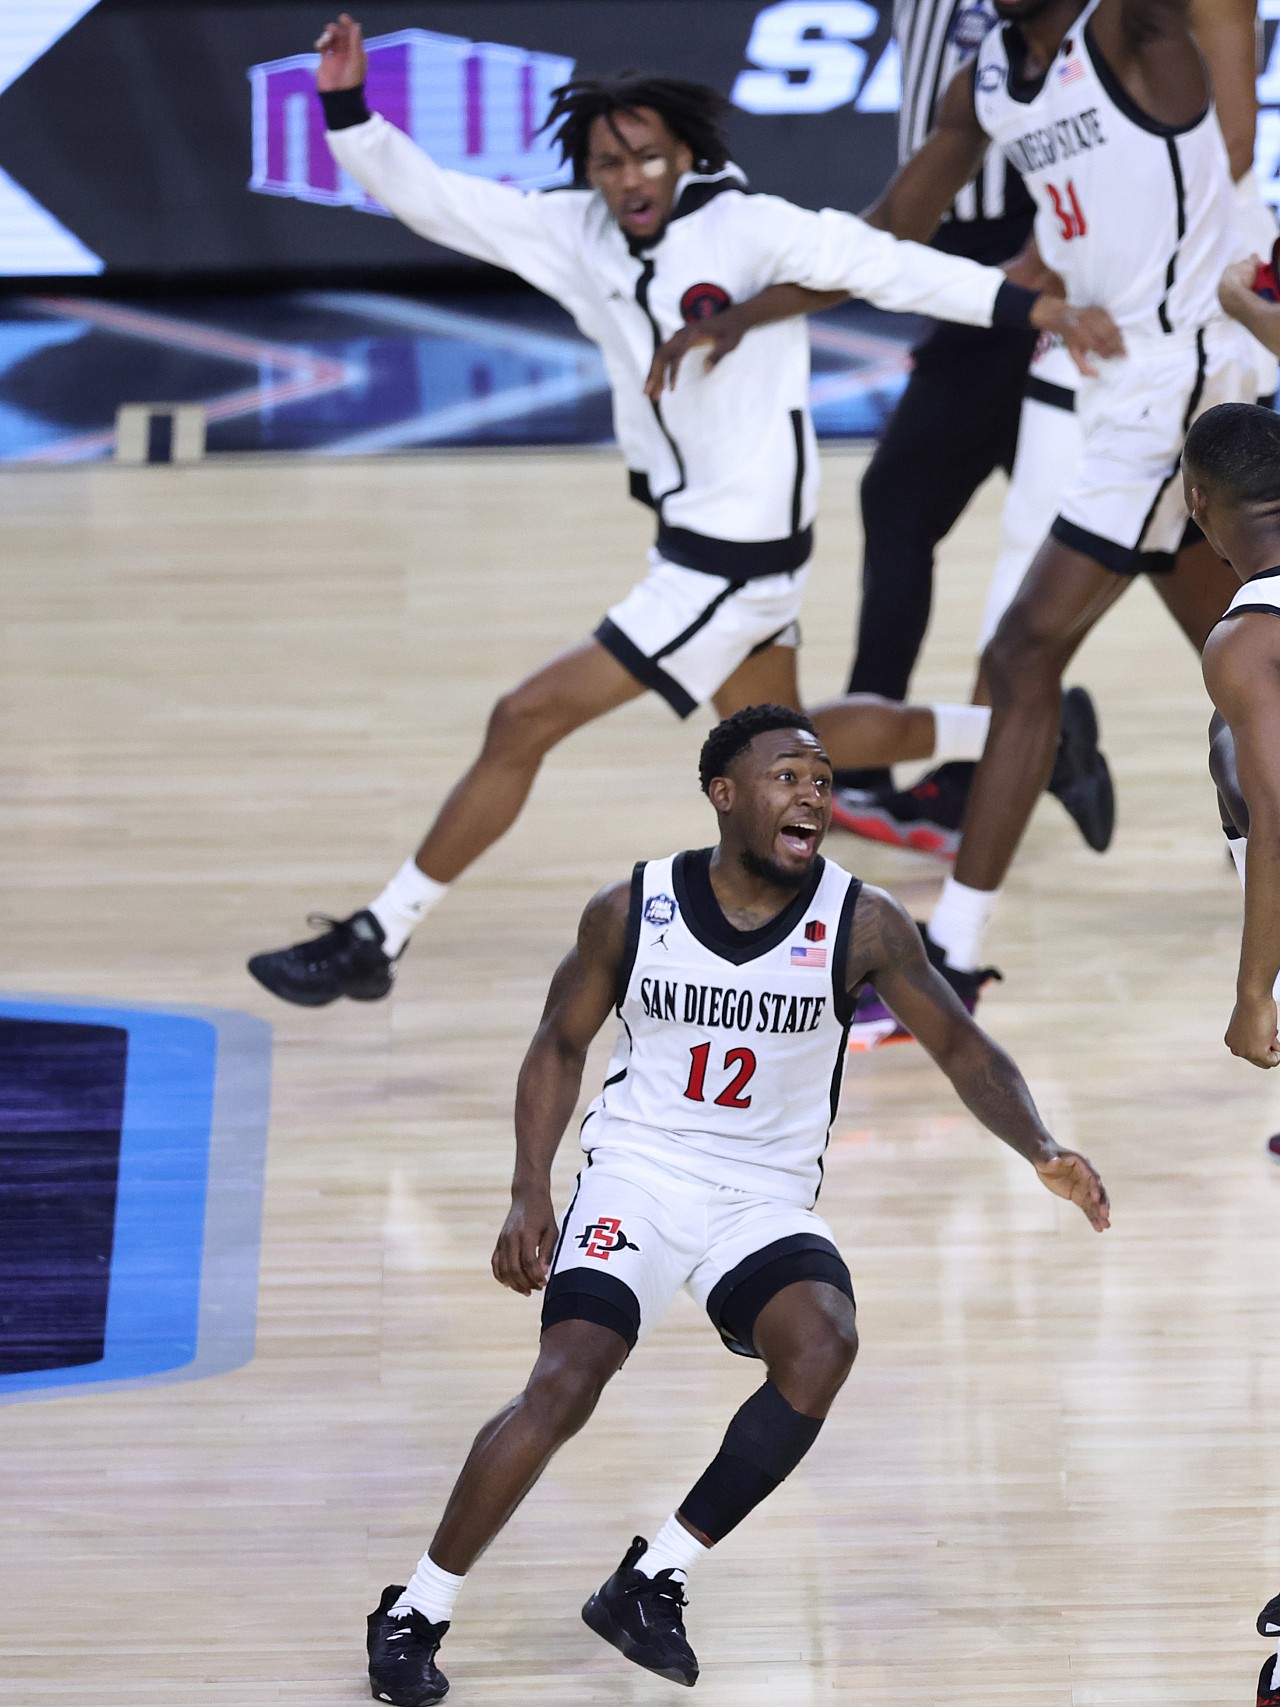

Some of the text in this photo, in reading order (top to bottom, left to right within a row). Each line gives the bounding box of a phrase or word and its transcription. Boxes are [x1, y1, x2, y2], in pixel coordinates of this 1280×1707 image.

[1046, 179, 1087, 241] 31
[640, 977, 827, 1034] SAN DIEGO STATE
[683, 1041, 757, 1109] 12
